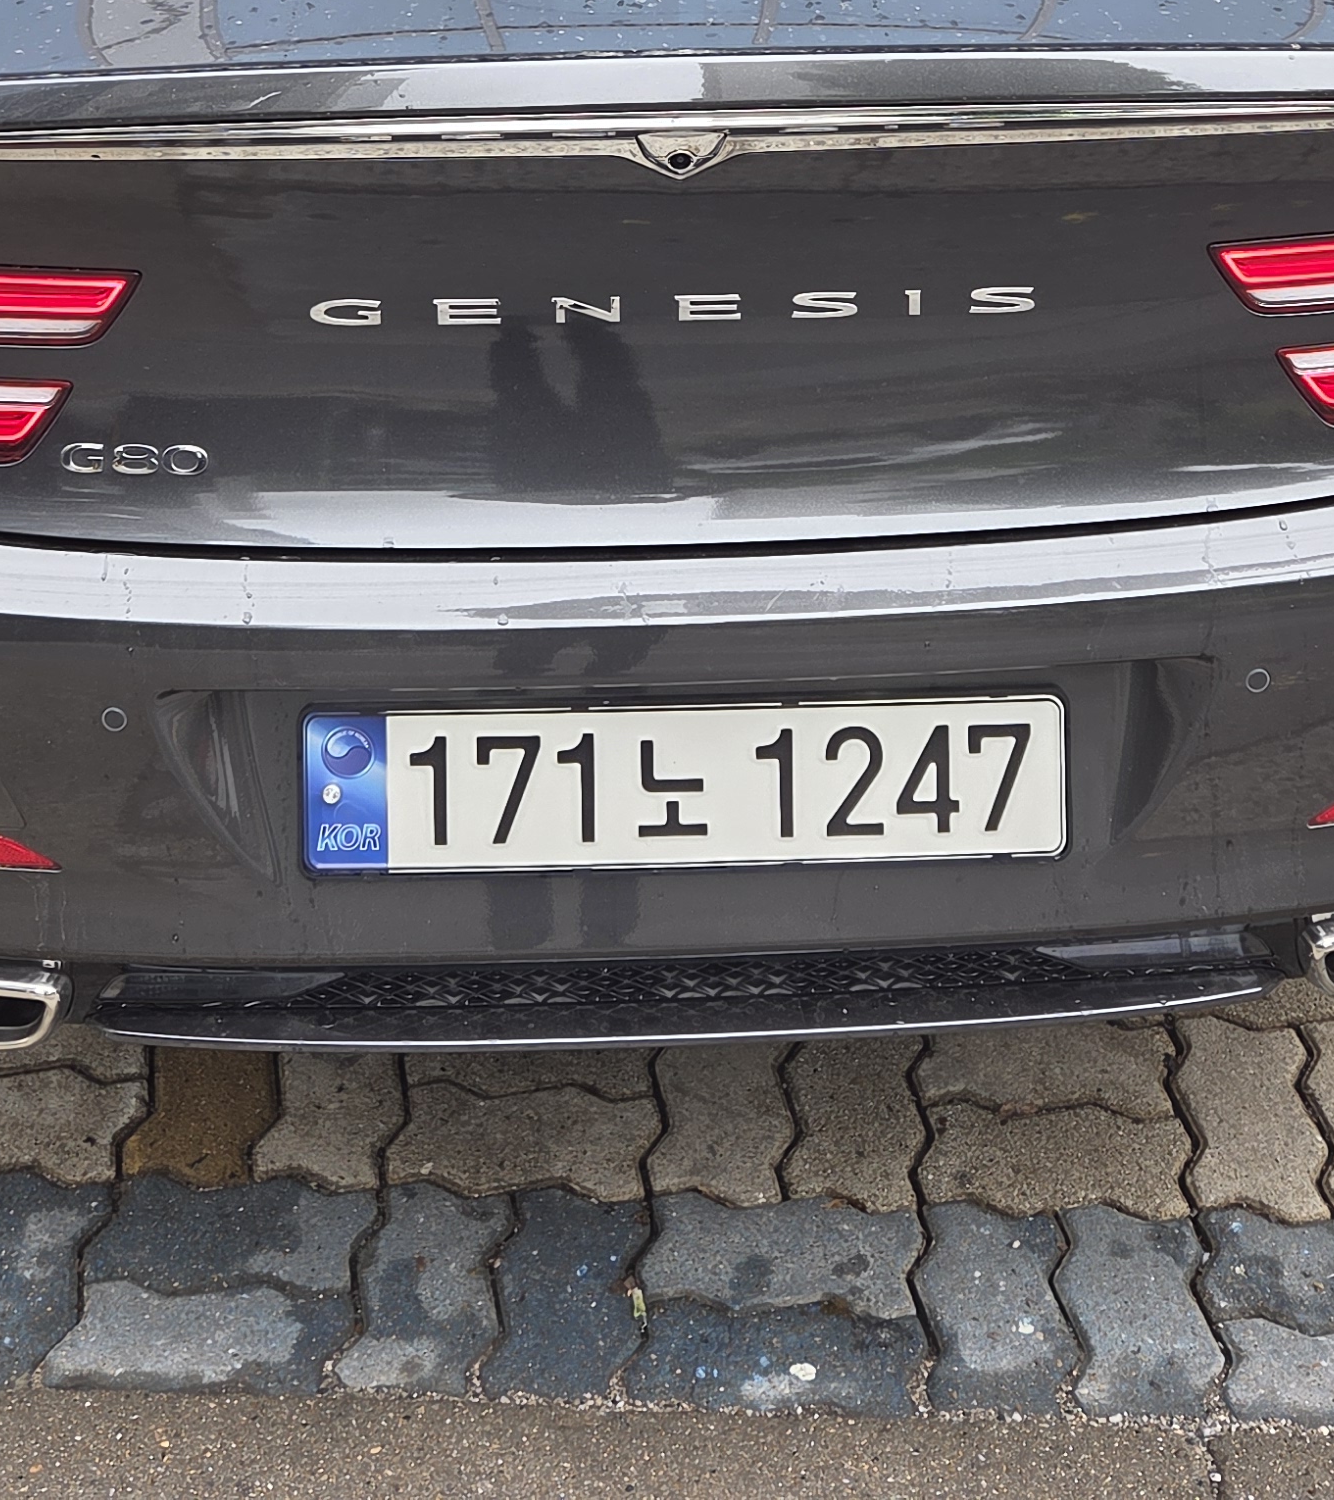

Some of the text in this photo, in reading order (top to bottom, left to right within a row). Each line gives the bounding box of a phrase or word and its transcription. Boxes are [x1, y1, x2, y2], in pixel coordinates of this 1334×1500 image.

[309, 286, 1036, 328] GENESIS
[59, 442, 209, 476] G80
[409, 723, 1033, 847] 171노 1247
[317, 823, 382, 853] KOR
